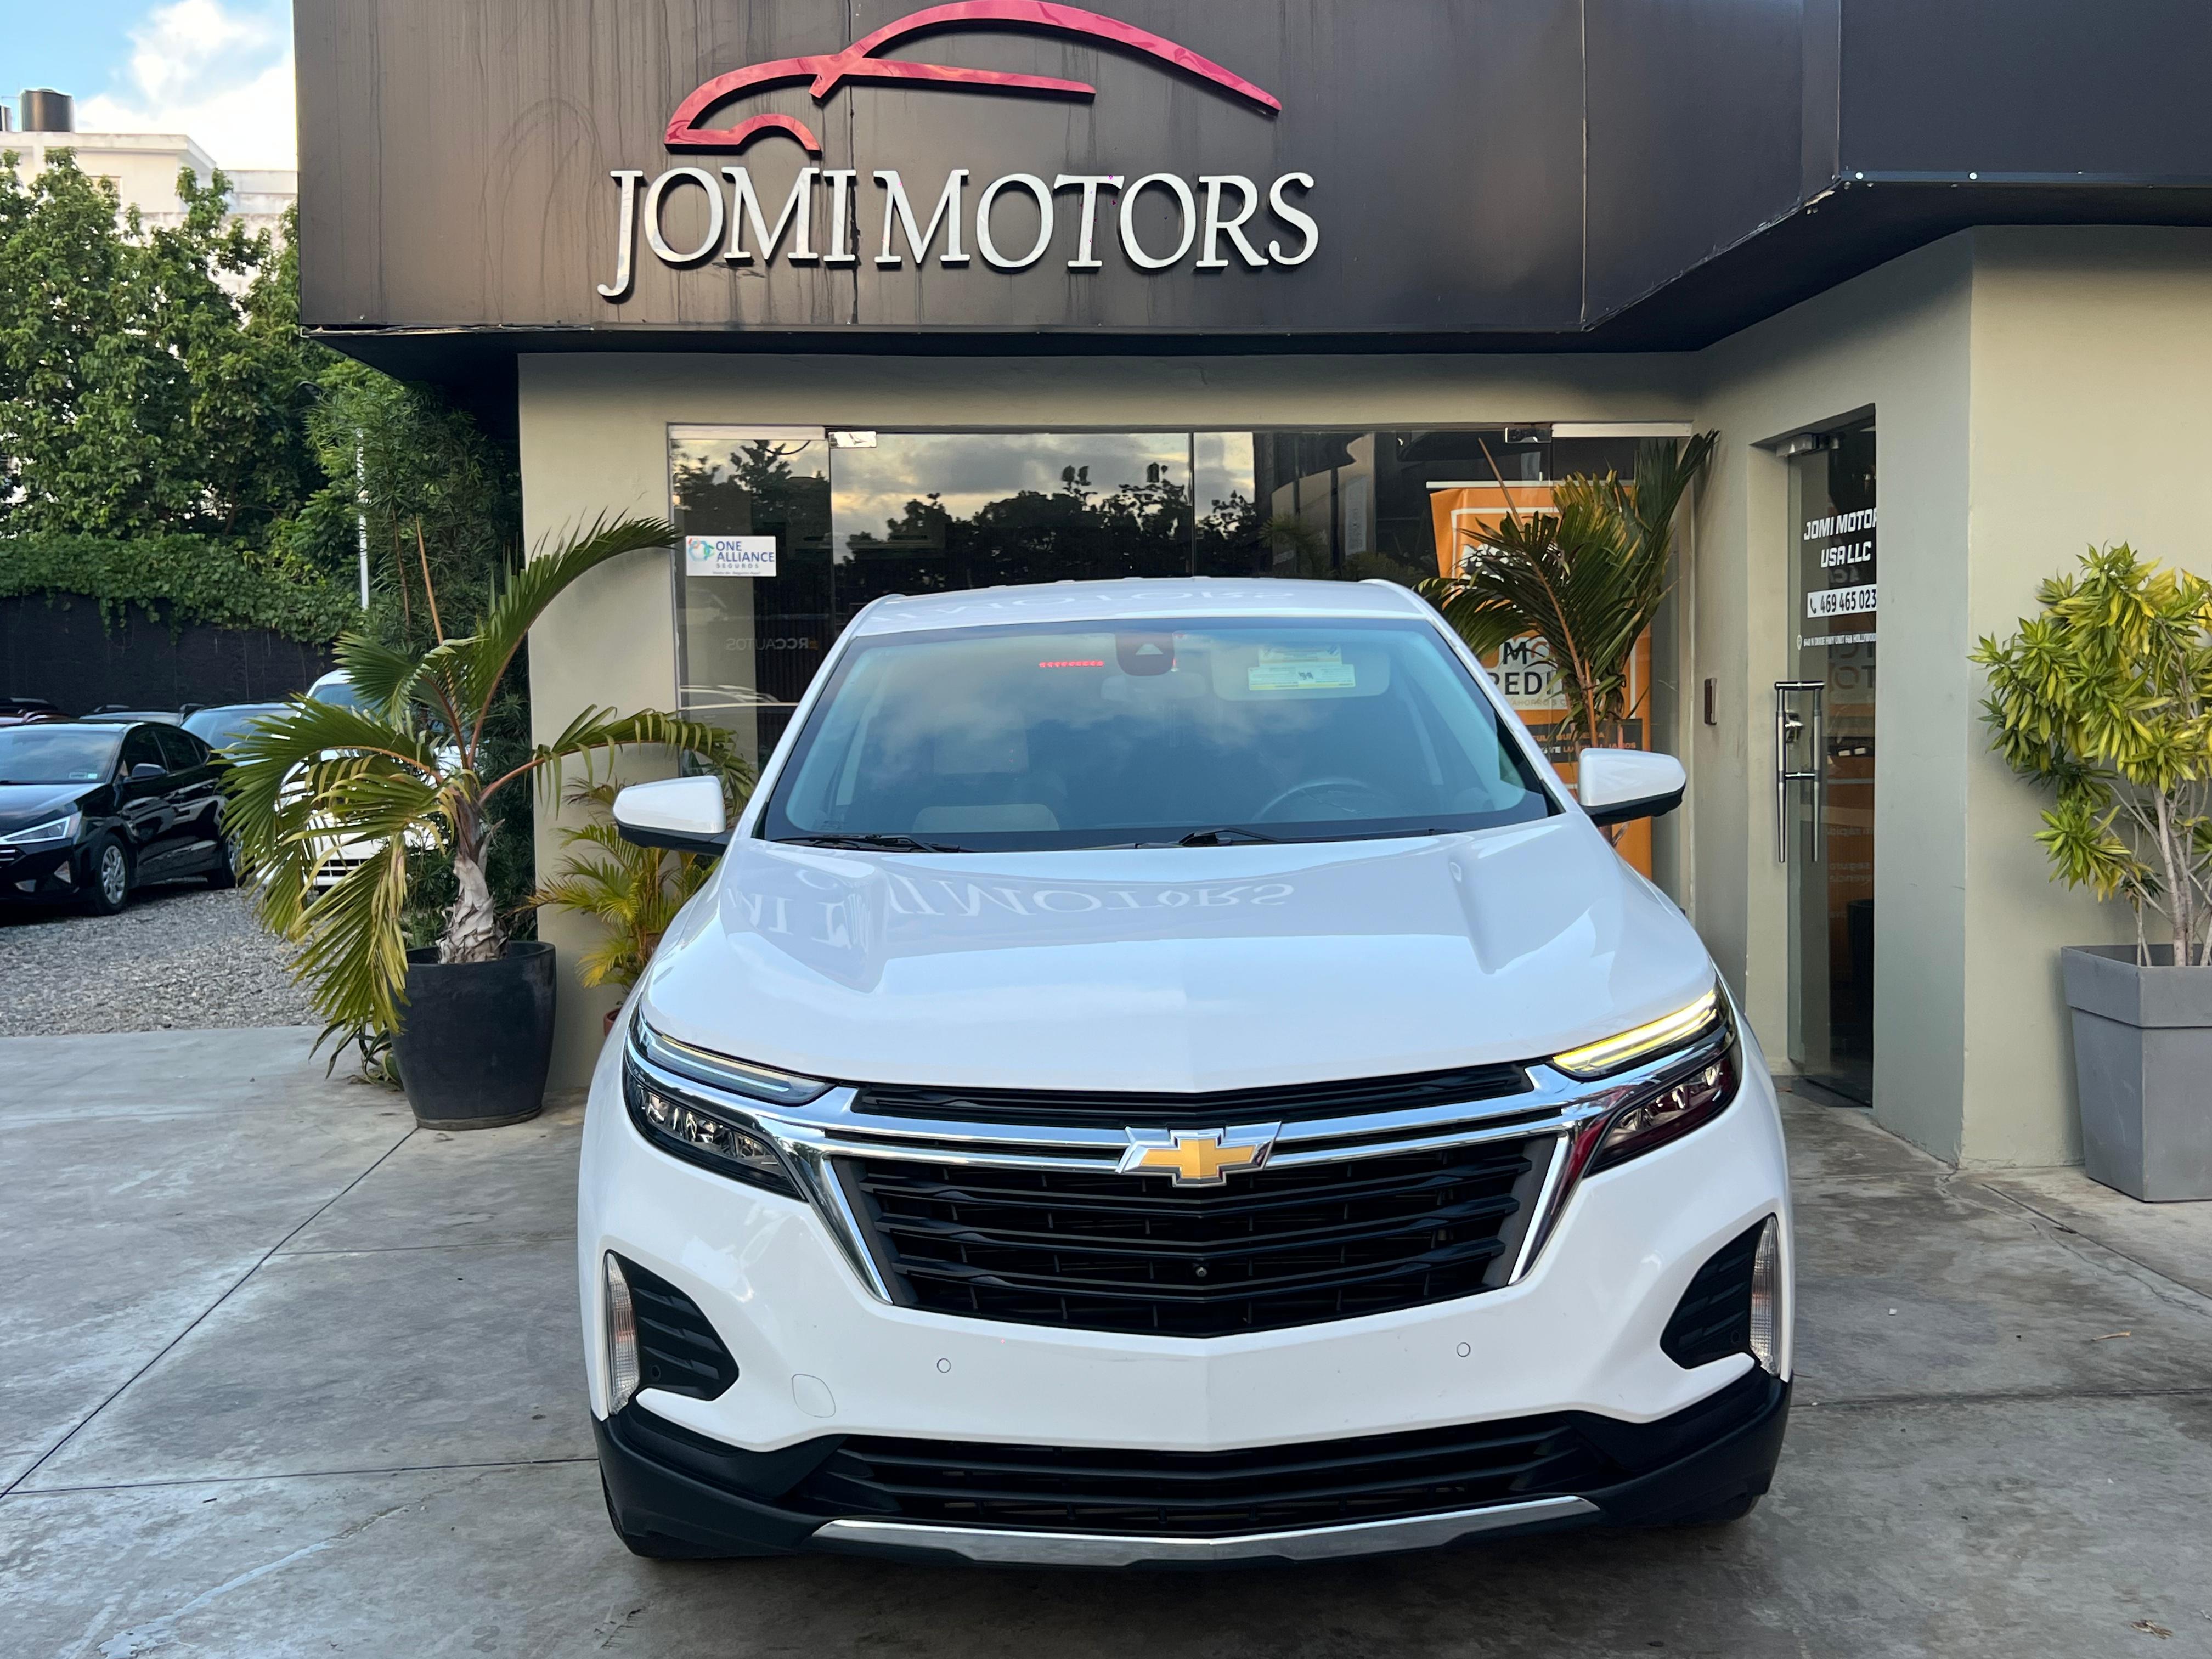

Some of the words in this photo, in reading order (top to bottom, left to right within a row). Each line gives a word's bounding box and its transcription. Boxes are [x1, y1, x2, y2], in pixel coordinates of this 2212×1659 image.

[597, 167, 857, 298] JOMI
[874, 168, 1319, 268] MOTORS
[1803, 516, 1835, 541] JOMI
[715, 541, 742, 551] ONE
[716, 551, 775, 562] ALLIANCE
[1820, 546, 1846, 568] USA
[1847, 541, 1872, 564] LLC
[1820, 594, 1837, 613] 469
[1839, 592, 1857, 611] 465
[1859, 589, 1876, 609] 023
